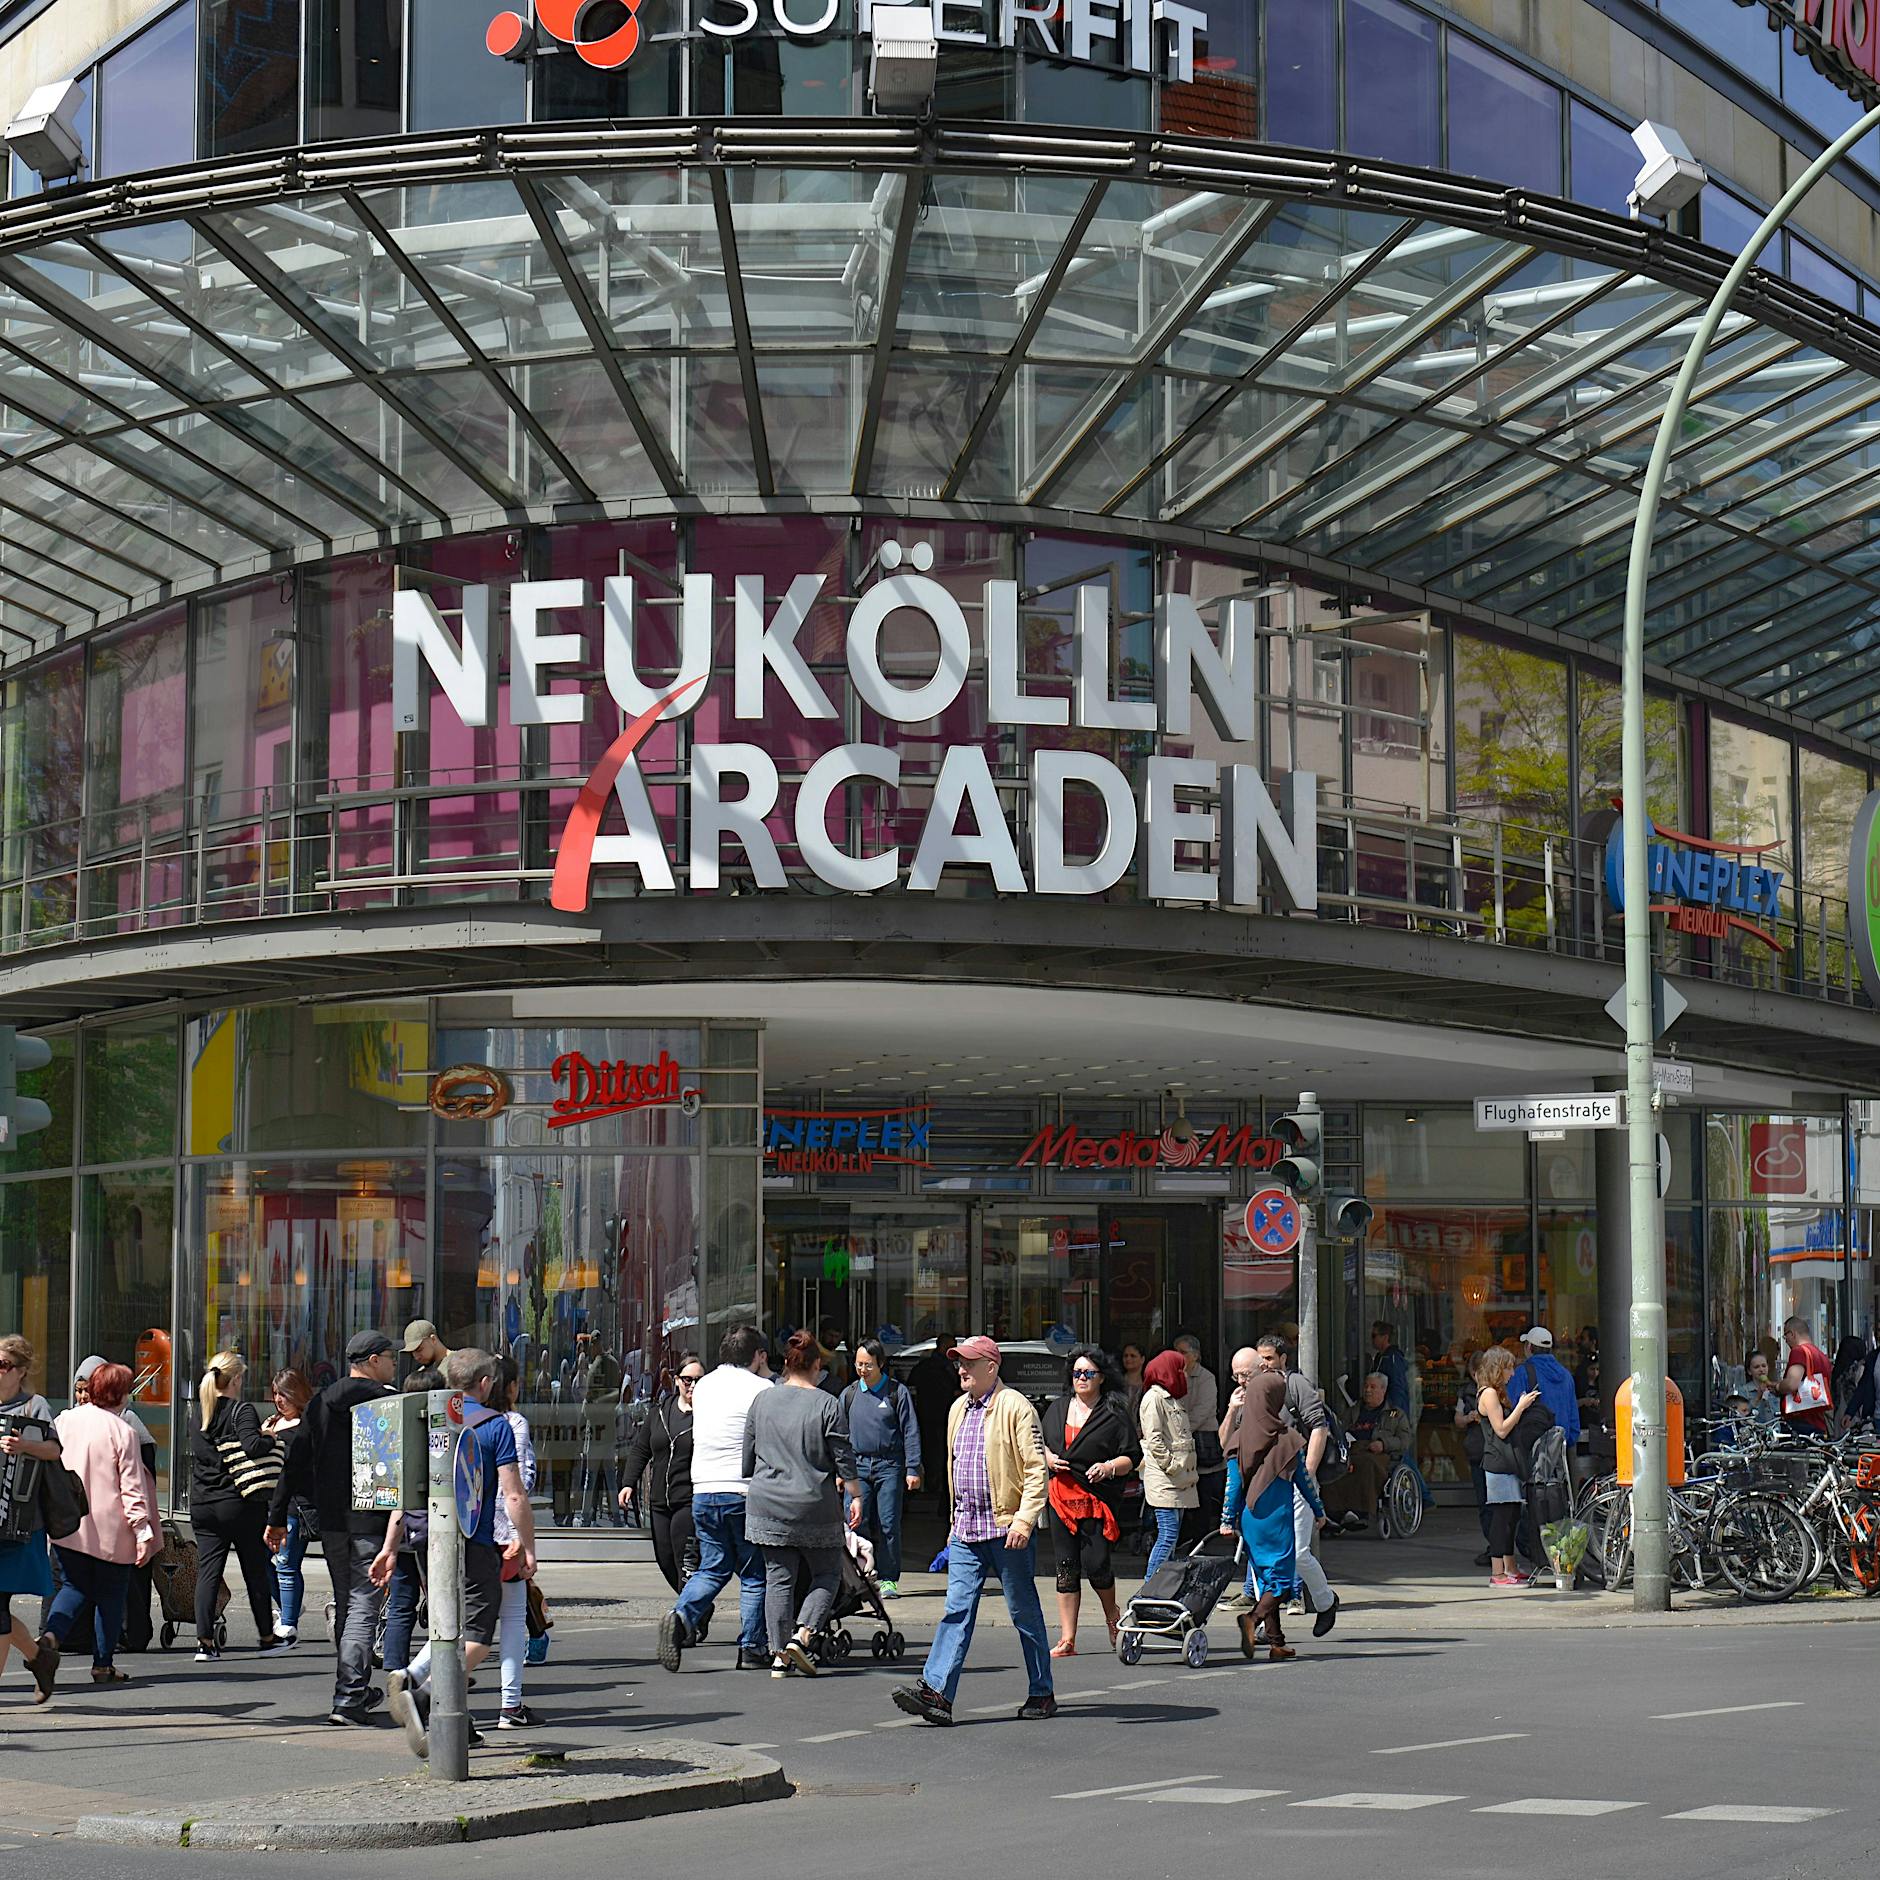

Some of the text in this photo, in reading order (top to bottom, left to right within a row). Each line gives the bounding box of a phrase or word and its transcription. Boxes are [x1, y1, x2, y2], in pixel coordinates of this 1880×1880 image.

[698, 0, 1208, 83] ERFIT
[393, 540, 1256, 742] NEUKÖLLN
[552, 740, 1318, 912] ARCADEN
[1677, 904, 1729, 939] NEUKÖLLN
[551, 1050, 680, 1113] Ditsch
[1653, 1065, 1692, 1088] arl-Marx-Straße
[1484, 1101, 1612, 1123] Flughafenstraße
[764, 1119, 933, 1150] NEPLEX
[1016, 1123, 1160, 1168] Media
[777, 1147, 873, 1175] NEUKÖLLN
[1023, 1362, 1053, 1370] HERZLICH
[529, 1423, 606, 1441] mmer
